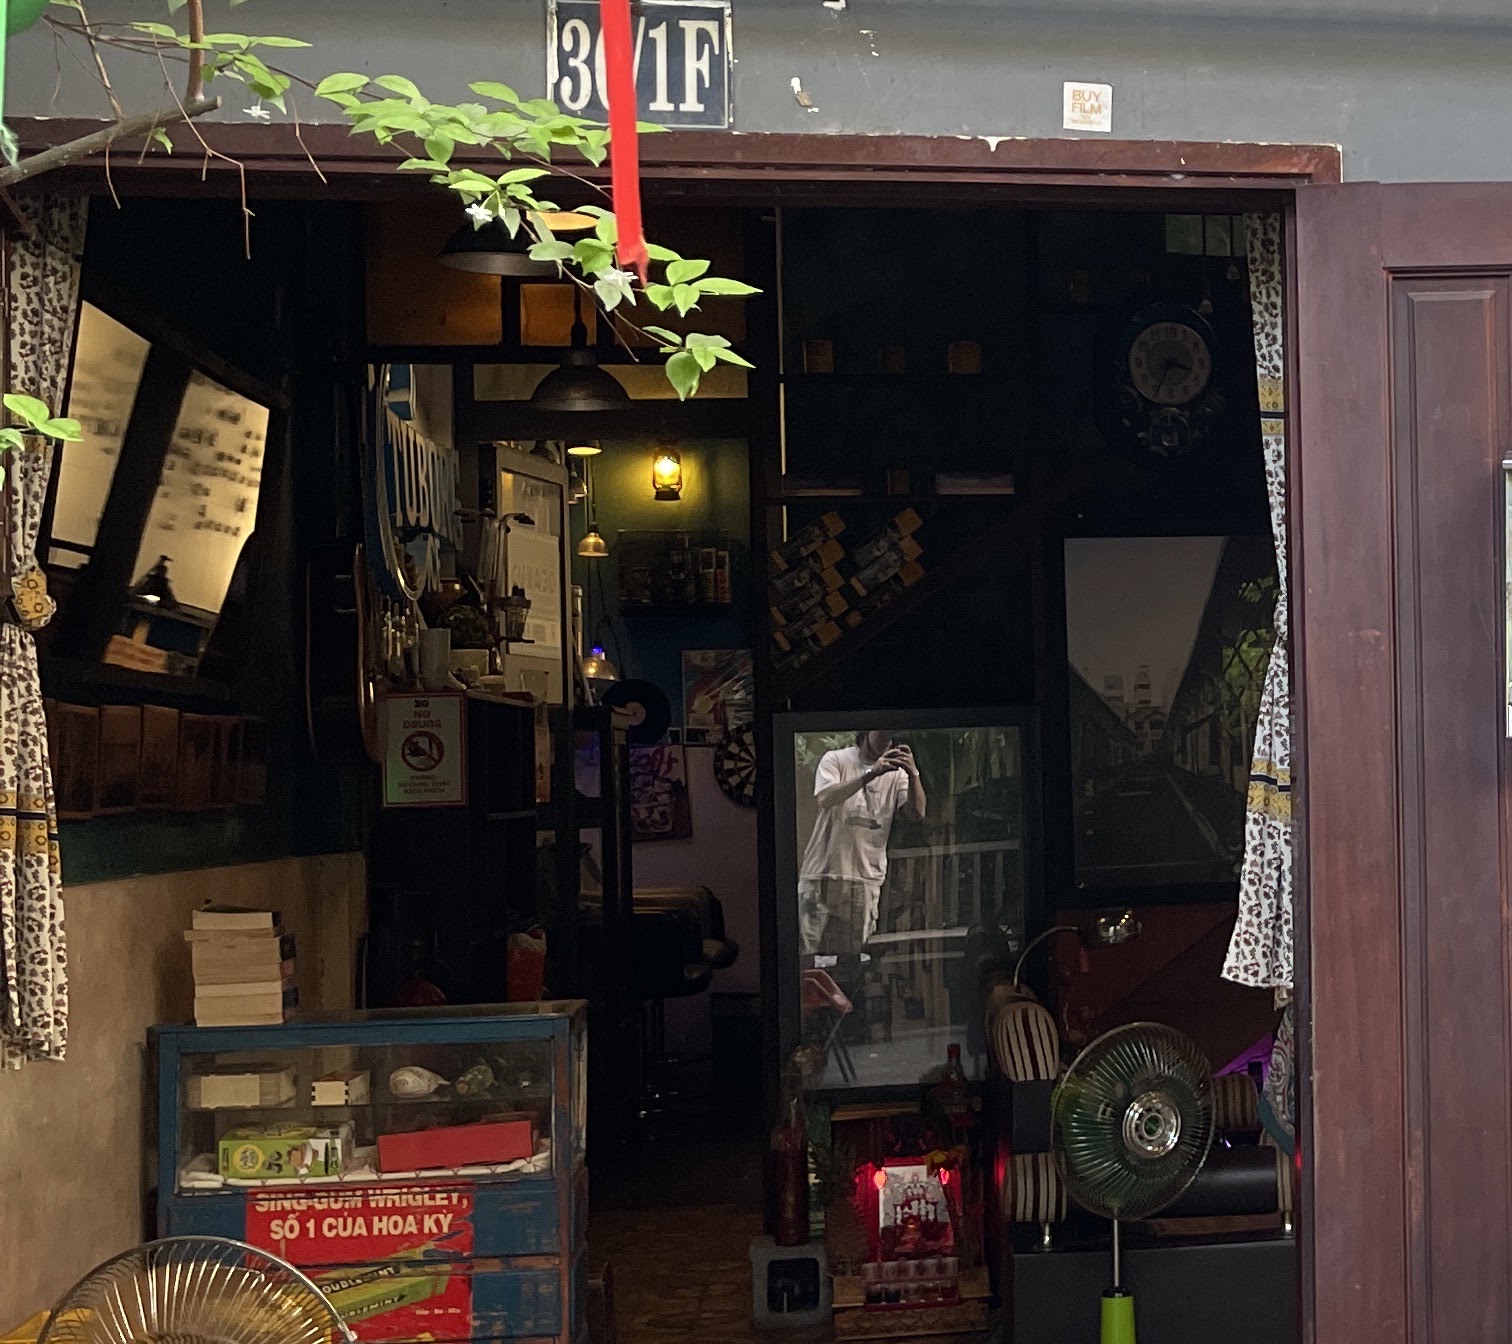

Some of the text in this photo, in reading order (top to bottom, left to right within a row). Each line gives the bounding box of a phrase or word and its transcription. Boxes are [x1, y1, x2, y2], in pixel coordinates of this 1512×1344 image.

[1072, 89, 1103, 102] BUY
[1072, 102, 1103, 115] FILM
[270, 1209, 454, 1240] SỐ 1 CỦA HOA KỲ
